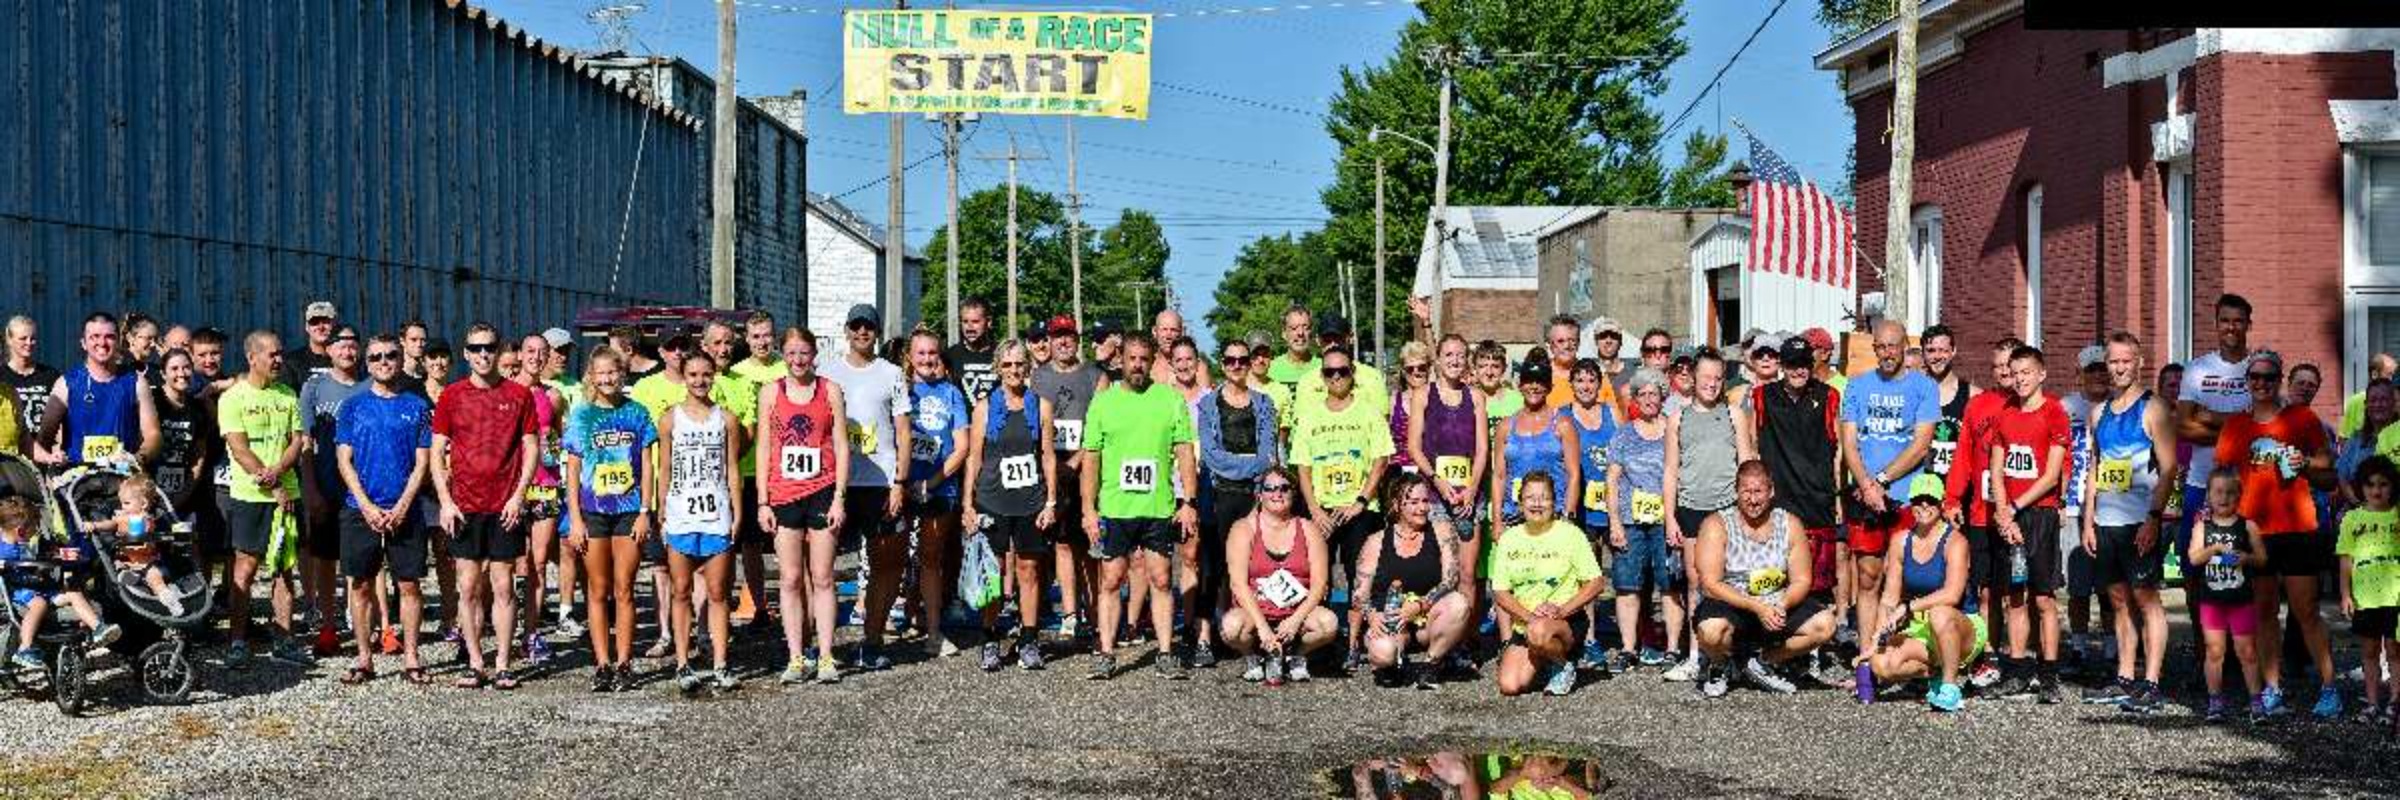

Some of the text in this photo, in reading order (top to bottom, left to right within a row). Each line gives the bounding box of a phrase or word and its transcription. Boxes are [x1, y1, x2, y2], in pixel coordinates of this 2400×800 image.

[1005, 17, 1027, 41] A
[1036, 15, 1147, 55] RACE
[888, 53, 1109, 95] START
[786, 453, 813, 473] 241
[2007, 451, 2033, 471] 209
[599, 471, 629, 487] 195
[1125, 465, 1152, 485] 240
[1327, 471, 1353, 486] 192
[1443, 465, 1468, 479] 179
[687, 493, 717, 515] 218
